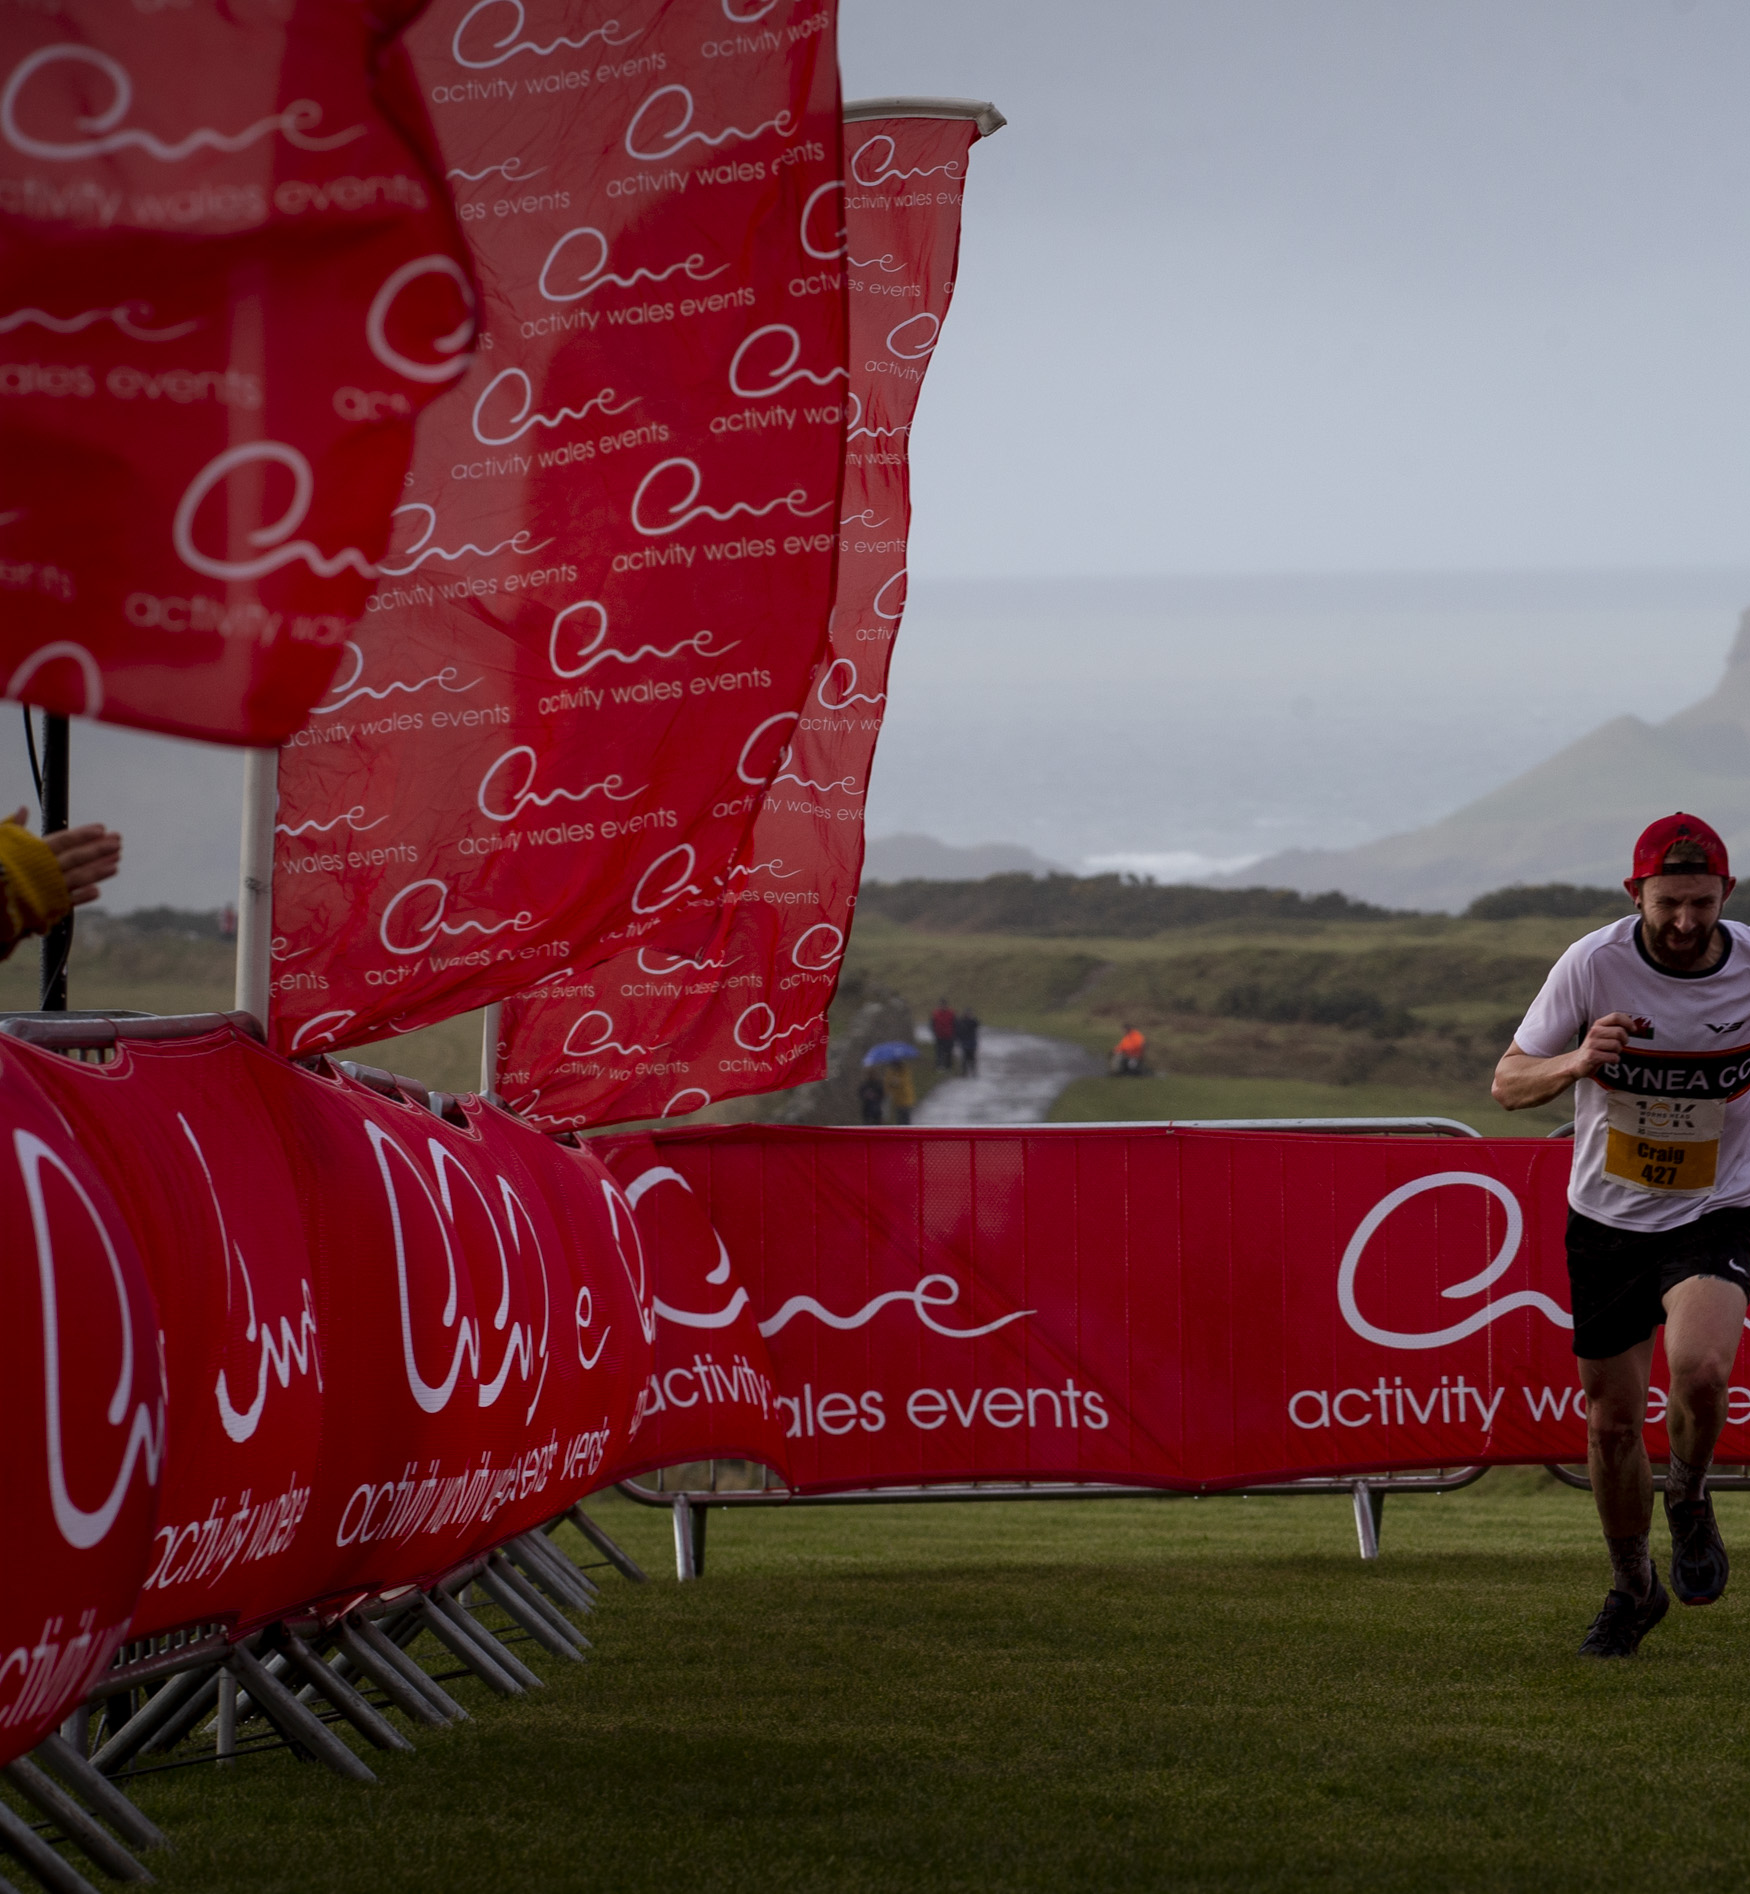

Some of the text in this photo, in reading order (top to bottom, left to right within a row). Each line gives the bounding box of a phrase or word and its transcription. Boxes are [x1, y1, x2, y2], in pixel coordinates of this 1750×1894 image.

[701, 28, 783, 59] activity
[432, 52, 667, 104] activity wales events
[274, 175, 428, 212] events
[606, 161, 765, 198] activity wales
[493, 191, 570, 217] events
[844, 191, 963, 211] activity wales eve
[788, 272, 841, 298] activ
[870, 282, 921, 297] events
[520, 286, 756, 339] activity wales events
[865, 359, 925, 383] activity
[0, 363, 262, 410] ales events
[710, 404, 797, 433] activity
[451, 422, 669, 481] activity wales events
[865, 451, 900, 465] wales
[612, 534, 775, 573] activity wales
[855, 538, 906, 553] events
[365, 562, 578, 614] activity wales events
[538, 667, 772, 714] activity wales events
[361, 709, 423, 736] wales
[431, 703, 511, 727] events
[799, 717, 854, 733] activity
[787, 799, 831, 819] wales
[836, 807, 864, 820] eve
[527, 807, 678, 846] wales events
[283, 841, 418, 875] wales events
[764, 889, 819, 905] events
[552, 983, 595, 999] events
[620, 983, 682, 998] activity
[779, 974, 836, 990] activity
[635, 1058, 689, 1075] events
[776, 1039, 816, 1066] wales
[1604, 1062, 1710, 1091] BYNEA
[1638, 1143, 1685, 1164] Craig
[1641, 1165, 1677, 1185] 427
[907, 1378, 1109, 1431] events
[1287, 1374, 1505, 1431] activity
[0, 1607, 97, 1732] ctivity
